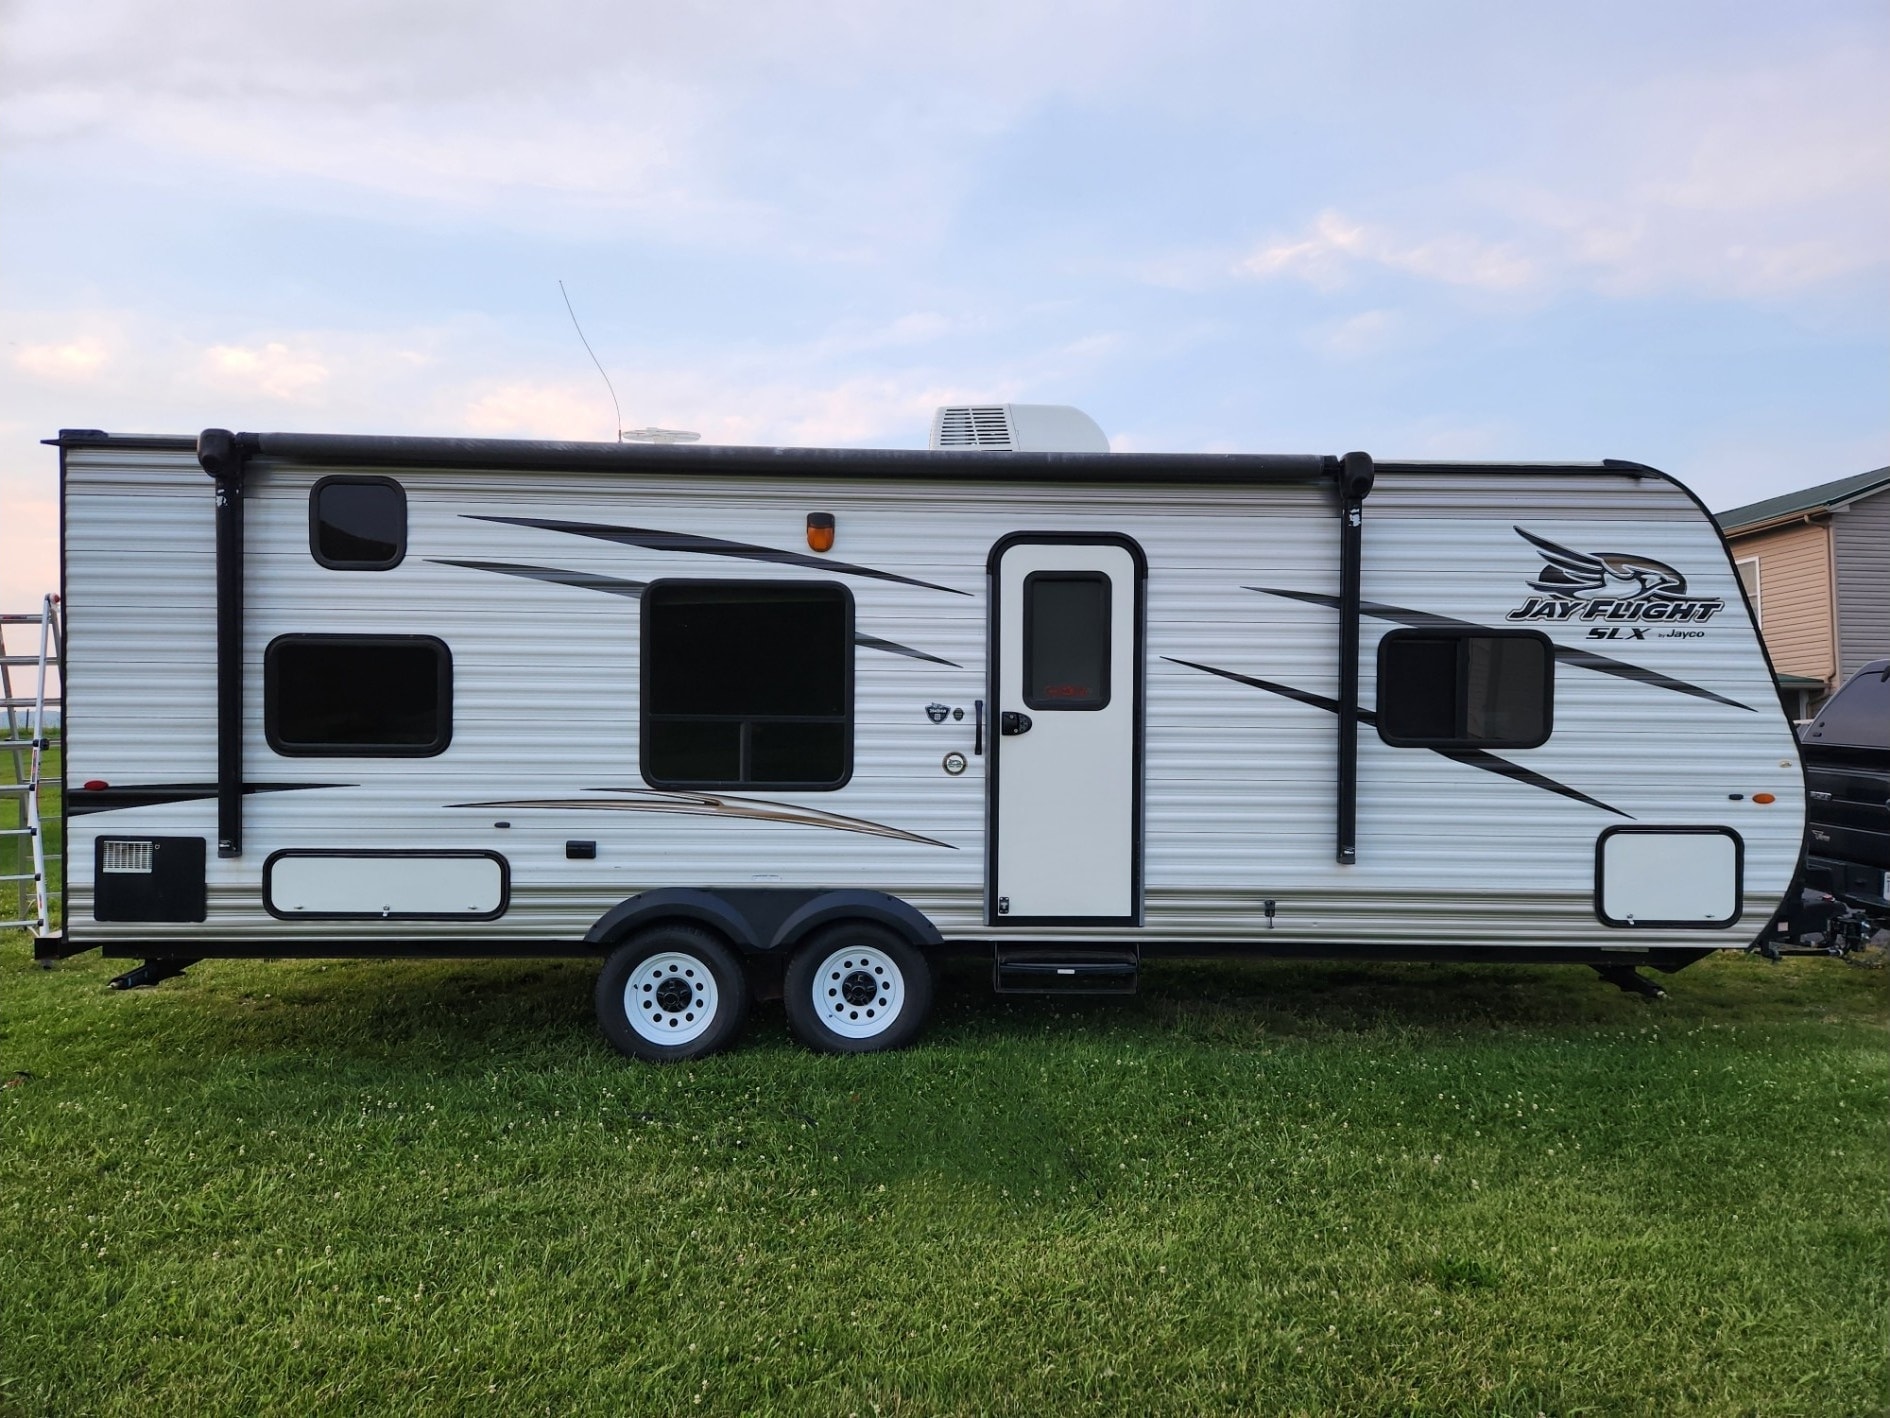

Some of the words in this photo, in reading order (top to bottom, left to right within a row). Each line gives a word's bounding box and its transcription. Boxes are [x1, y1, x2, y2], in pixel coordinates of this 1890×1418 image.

[1507, 597, 1585, 621] JAY
[1580, 598, 1725, 622] FLIGHT
[1586, 628, 1650, 640] SLX
[1666, 629, 1705, 640] Jayco
